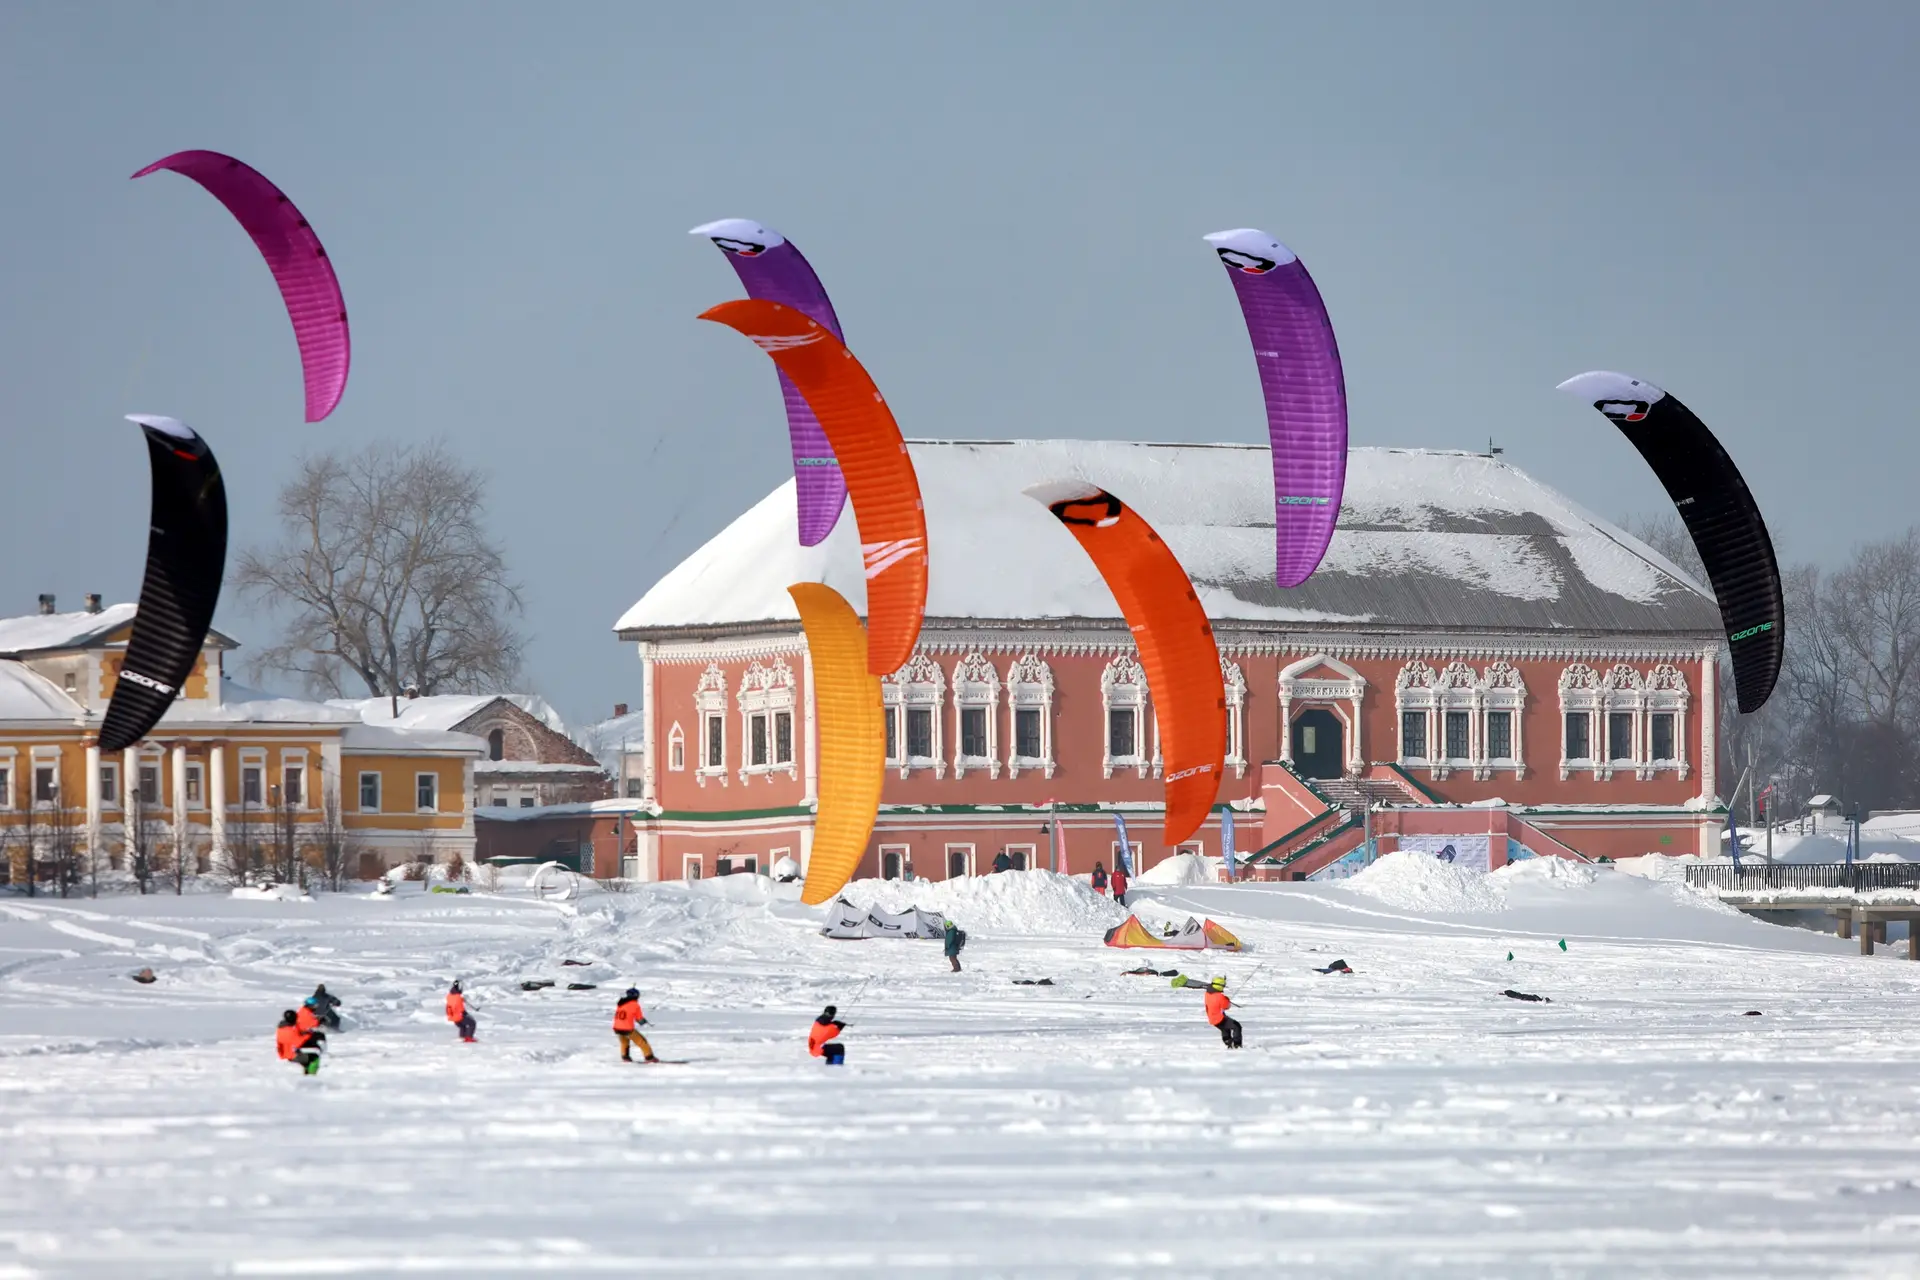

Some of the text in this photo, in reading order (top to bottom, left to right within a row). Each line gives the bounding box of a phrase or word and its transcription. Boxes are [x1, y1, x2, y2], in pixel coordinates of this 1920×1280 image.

[1731, 621, 1775, 641] OZONE
[120, 670, 175, 694] OZONE
[1165, 763, 1216, 783] OZONE
